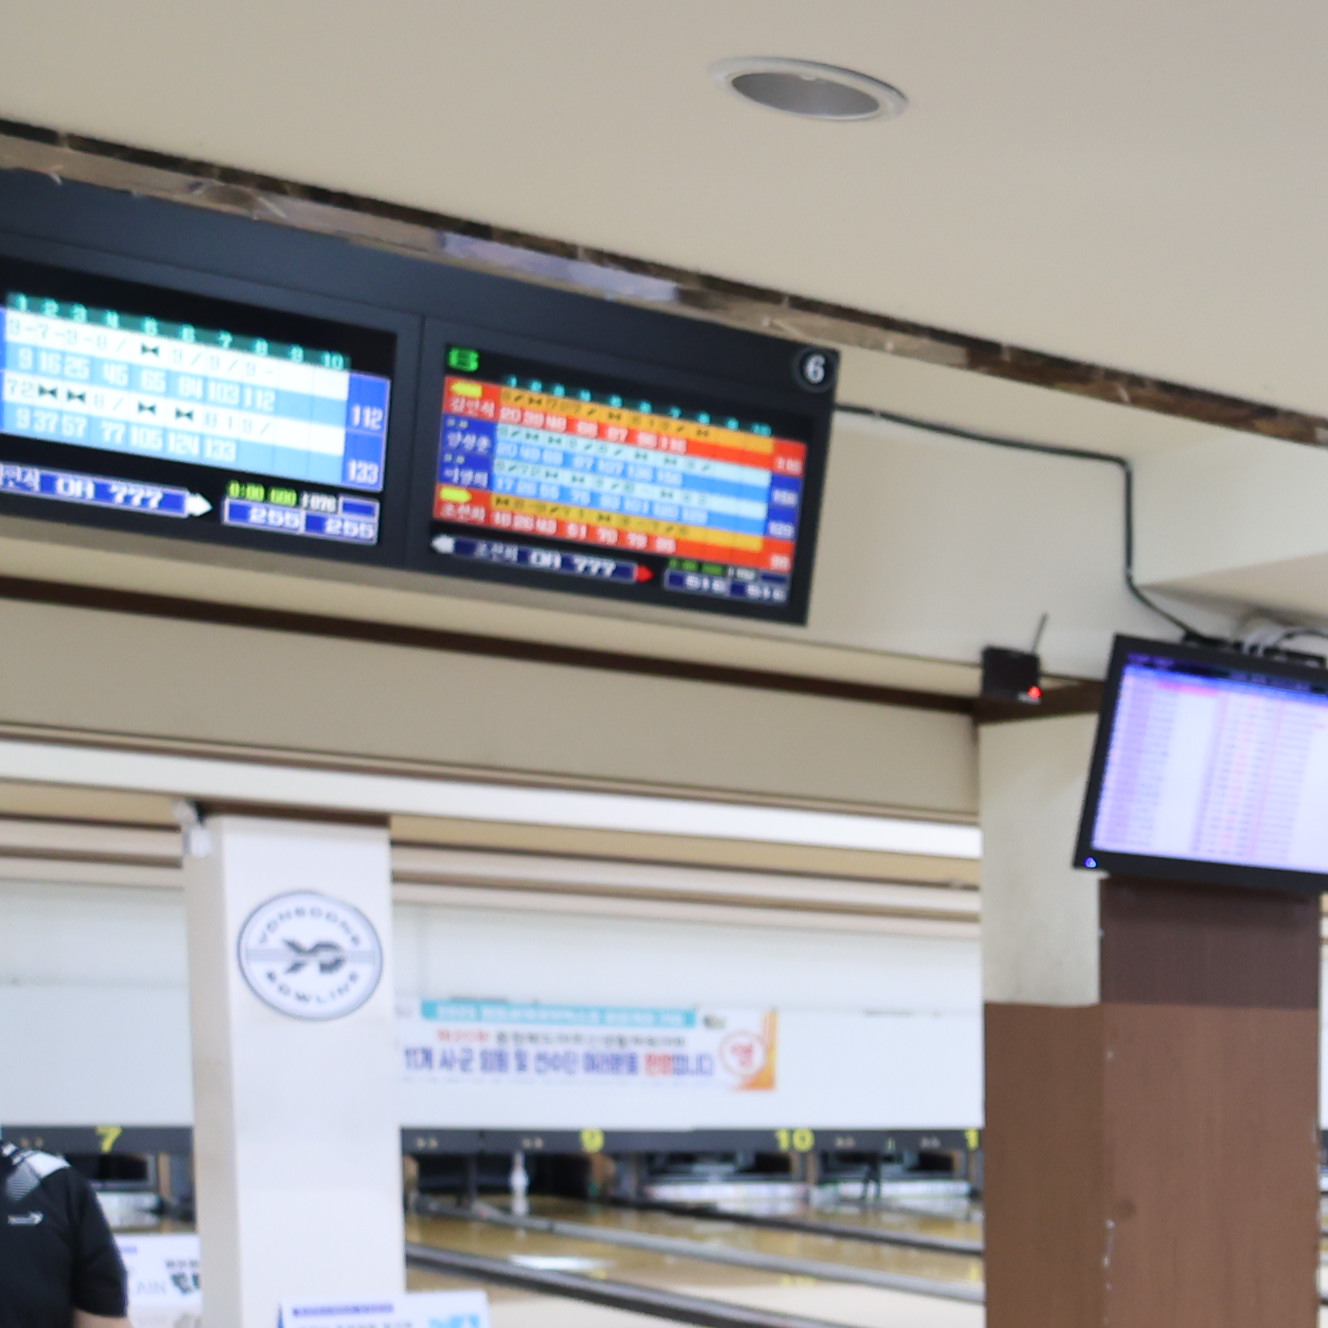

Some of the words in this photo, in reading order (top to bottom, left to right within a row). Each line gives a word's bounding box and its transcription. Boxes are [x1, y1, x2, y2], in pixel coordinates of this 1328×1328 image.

[320, 351, 345, 371] 10
[804, 353, 826, 384] 6
[351, 403, 383, 430] 112
[348, 459, 379, 485] 133
[250, 506, 299, 528] 255
[325, 518, 374, 540] 255
[95, 1126, 122, 1153] 7
[580, 1128, 604, 1153] 9
[775, 1128, 814, 1152] 10
